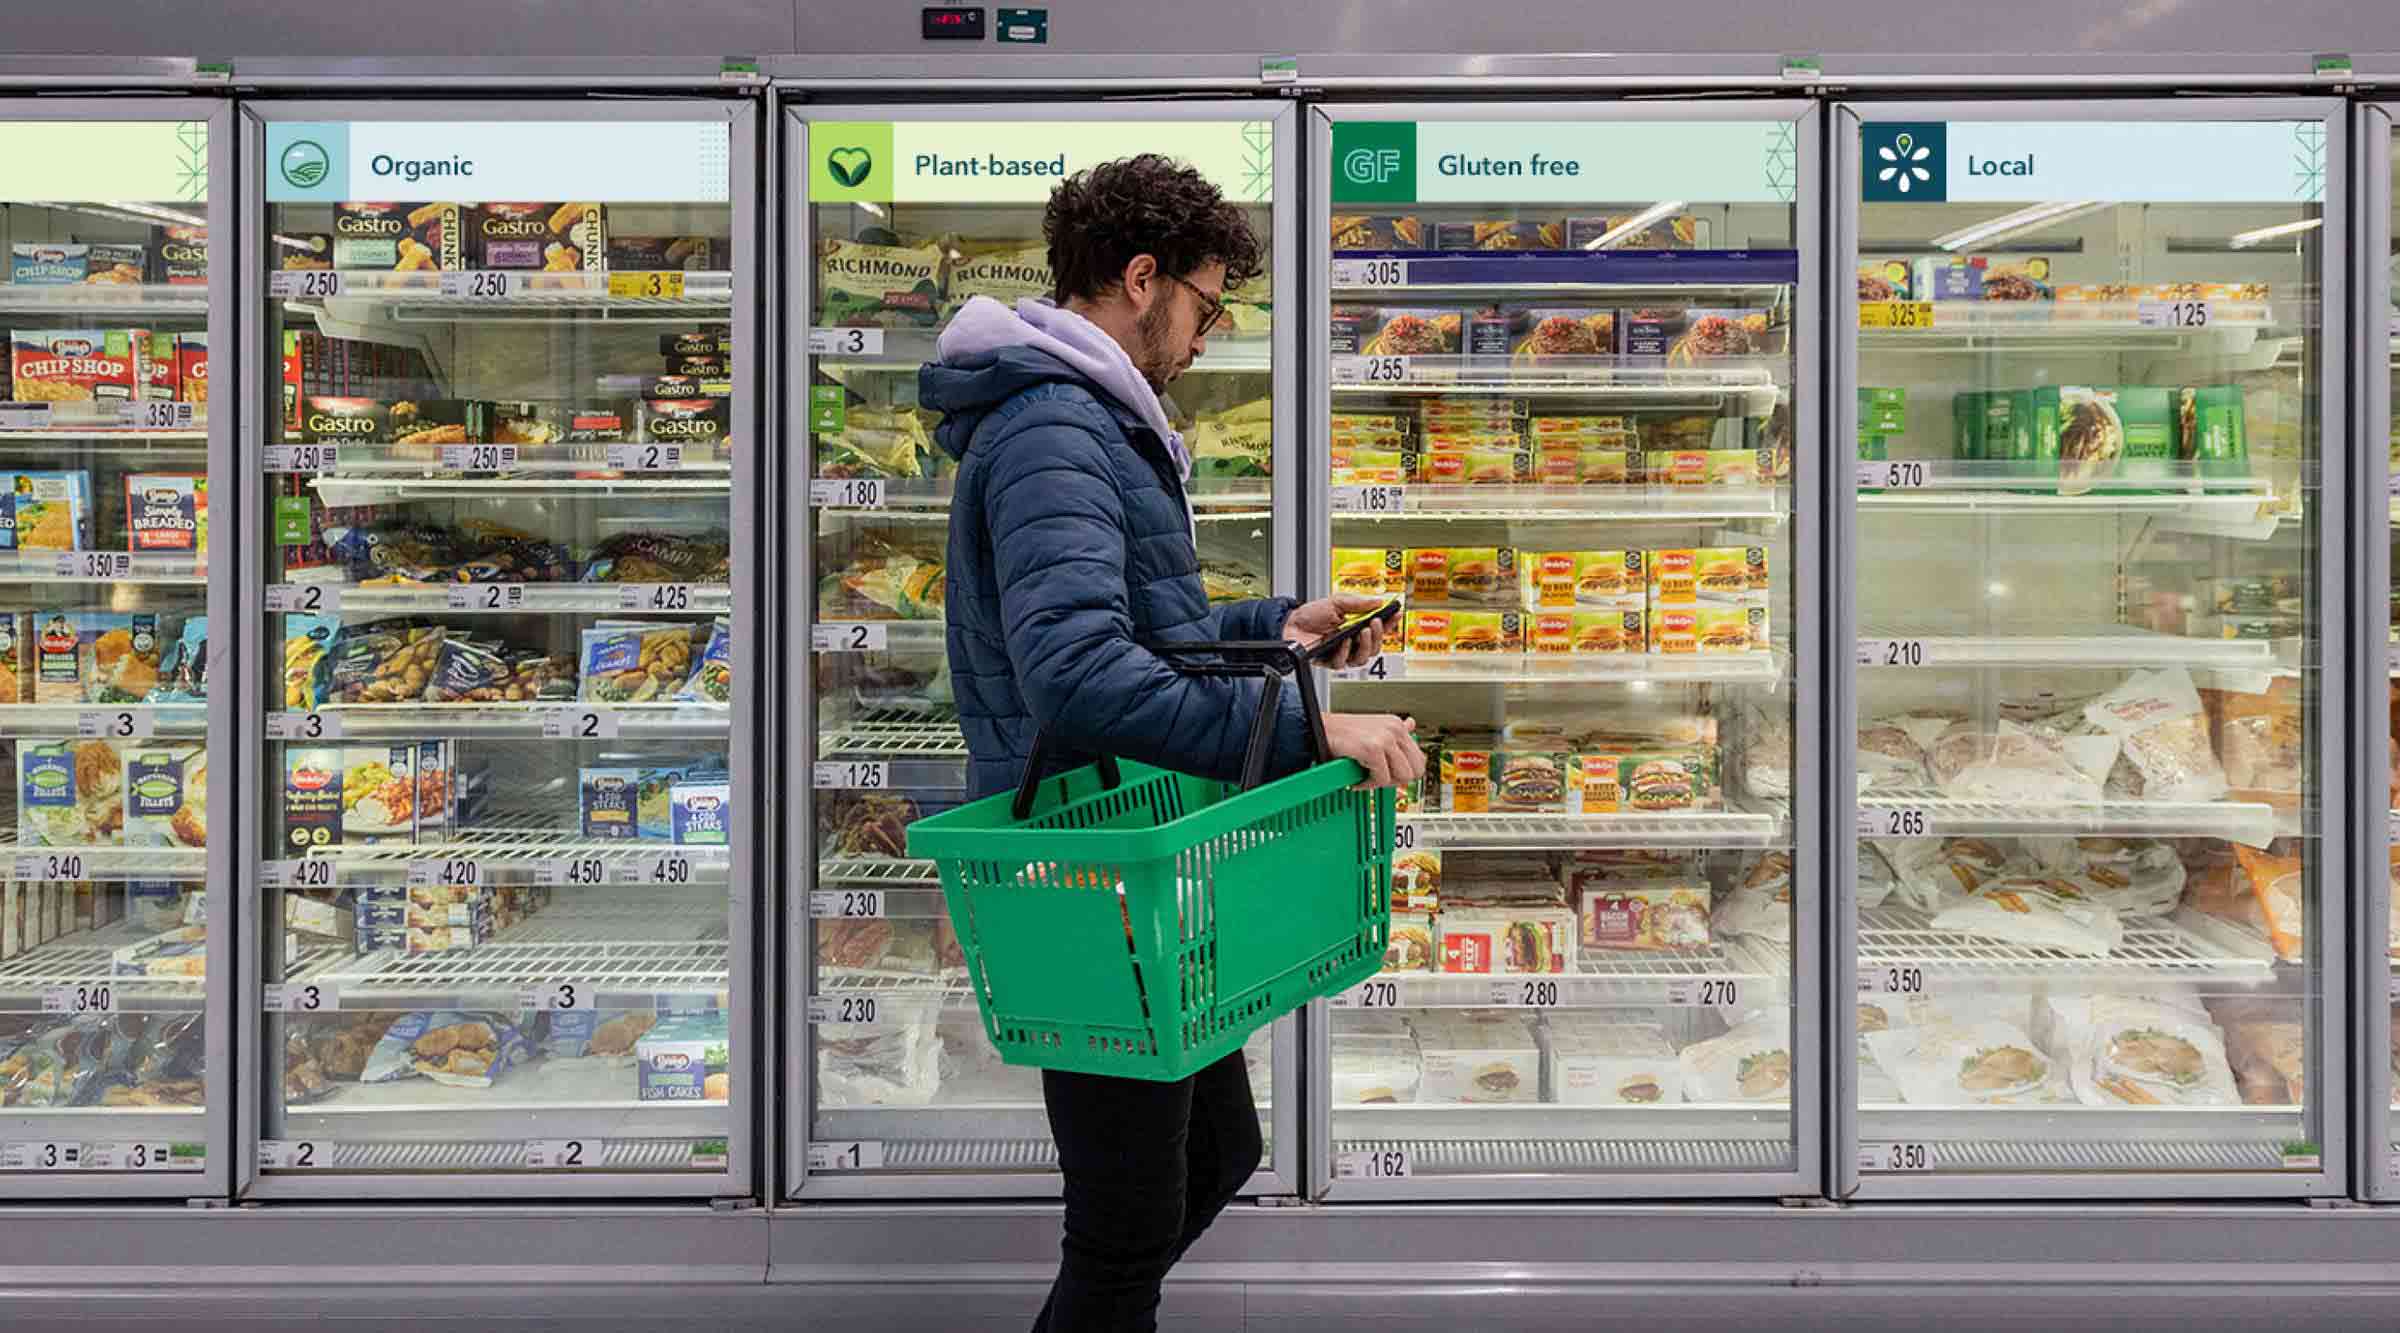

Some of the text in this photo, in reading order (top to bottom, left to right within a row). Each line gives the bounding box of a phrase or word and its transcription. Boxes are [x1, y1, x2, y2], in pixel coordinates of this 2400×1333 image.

[371, 153, 473, 182] Organic
[915, 153, 1065, 176] Plant-based
[1344, 149, 1400, 183] GF
[1438, 153, 1580, 176] Gluten free
[1968, 153, 2034, 176] Local
[337, 215, 402, 233] Gastro
[482, 217, 545, 235] Gastro
[443, 208, 456, 267] CHUNK
[585, 209, 598, 267] CHUNK
[826, 258, 931, 278] RICHMOND
[21, 359, 125, 378] CHIP SHOP
[680, 363, 720, 375] Gastro
[655, 384, 696, 396] Gastro
[309, 414, 375, 433] Gastro
[650, 417, 717, 434] Gastro
[134, 518, 195, 530] BREADED
[667, 1086, 702, 1099] CAKES
